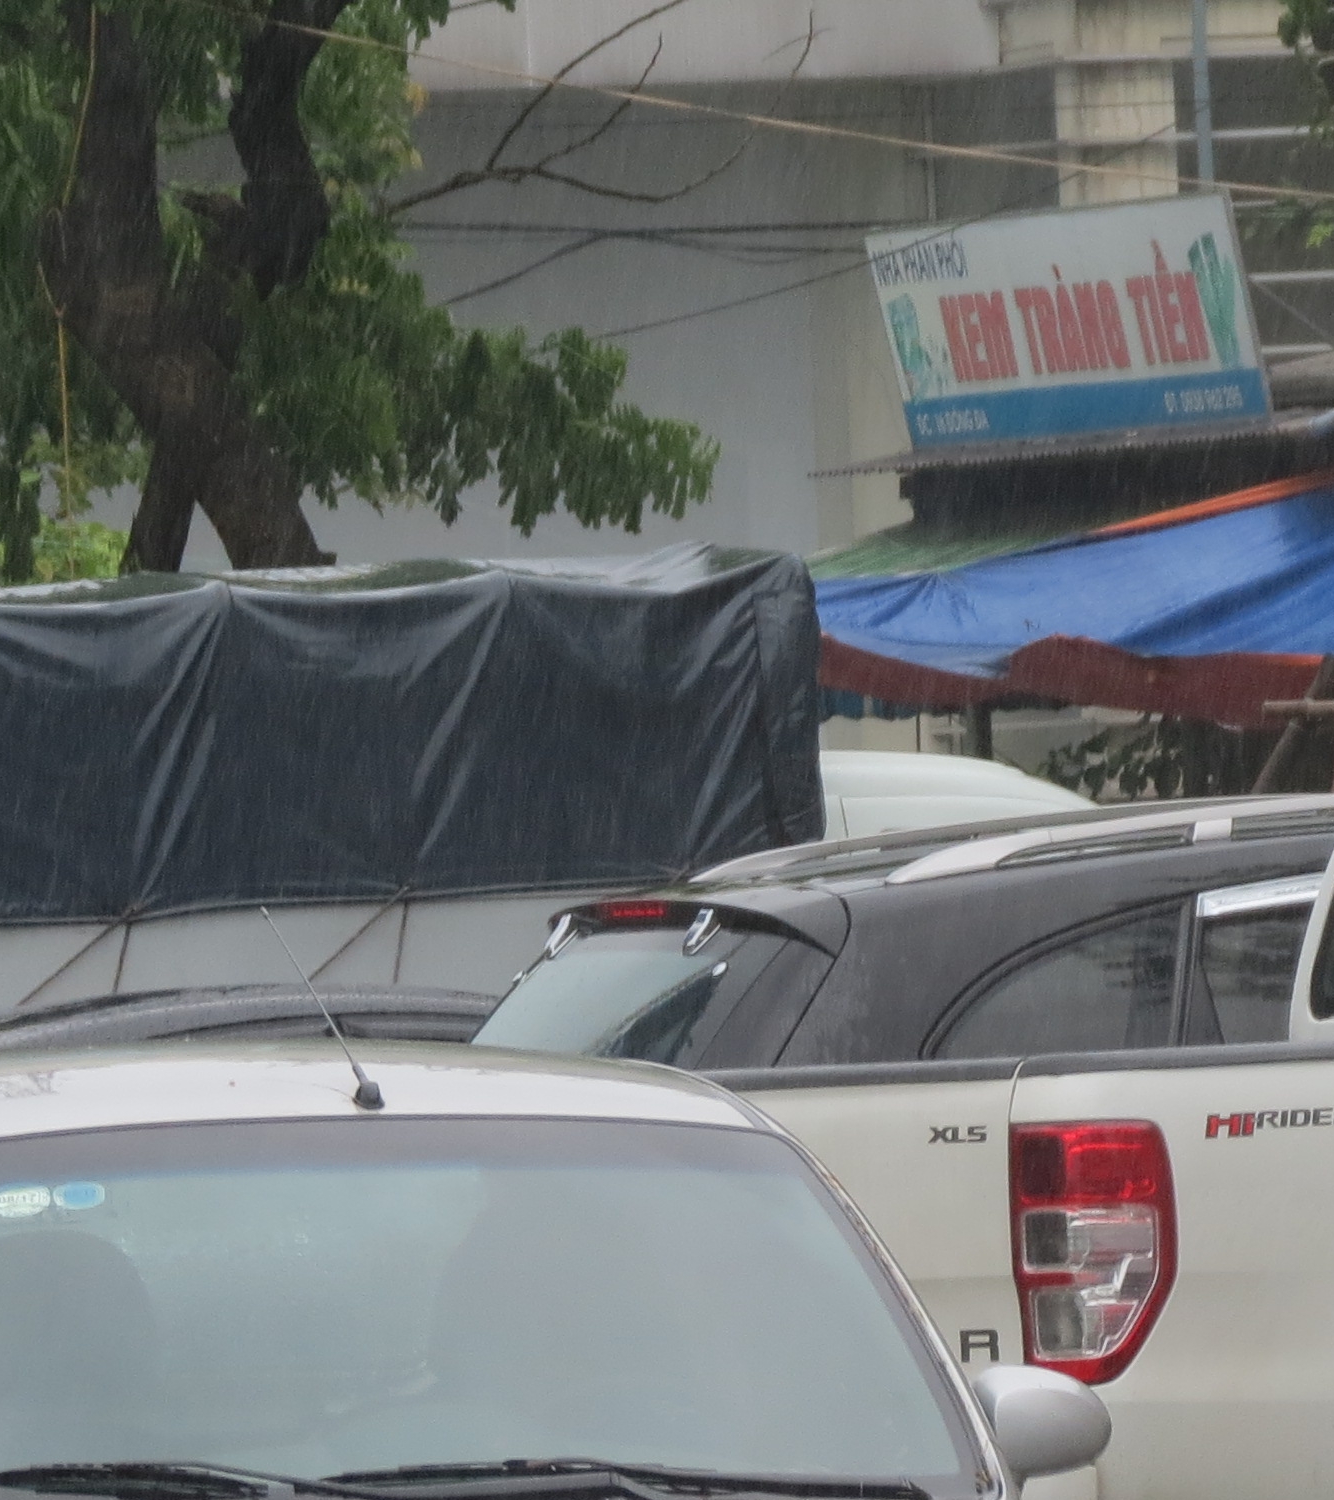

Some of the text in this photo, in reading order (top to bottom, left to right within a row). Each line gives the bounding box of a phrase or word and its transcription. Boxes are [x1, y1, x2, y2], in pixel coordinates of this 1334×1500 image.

[938, 238, 1210, 383] KEM TRÀNG TIỀN
[927, 1125, 988, 1145] XLS
